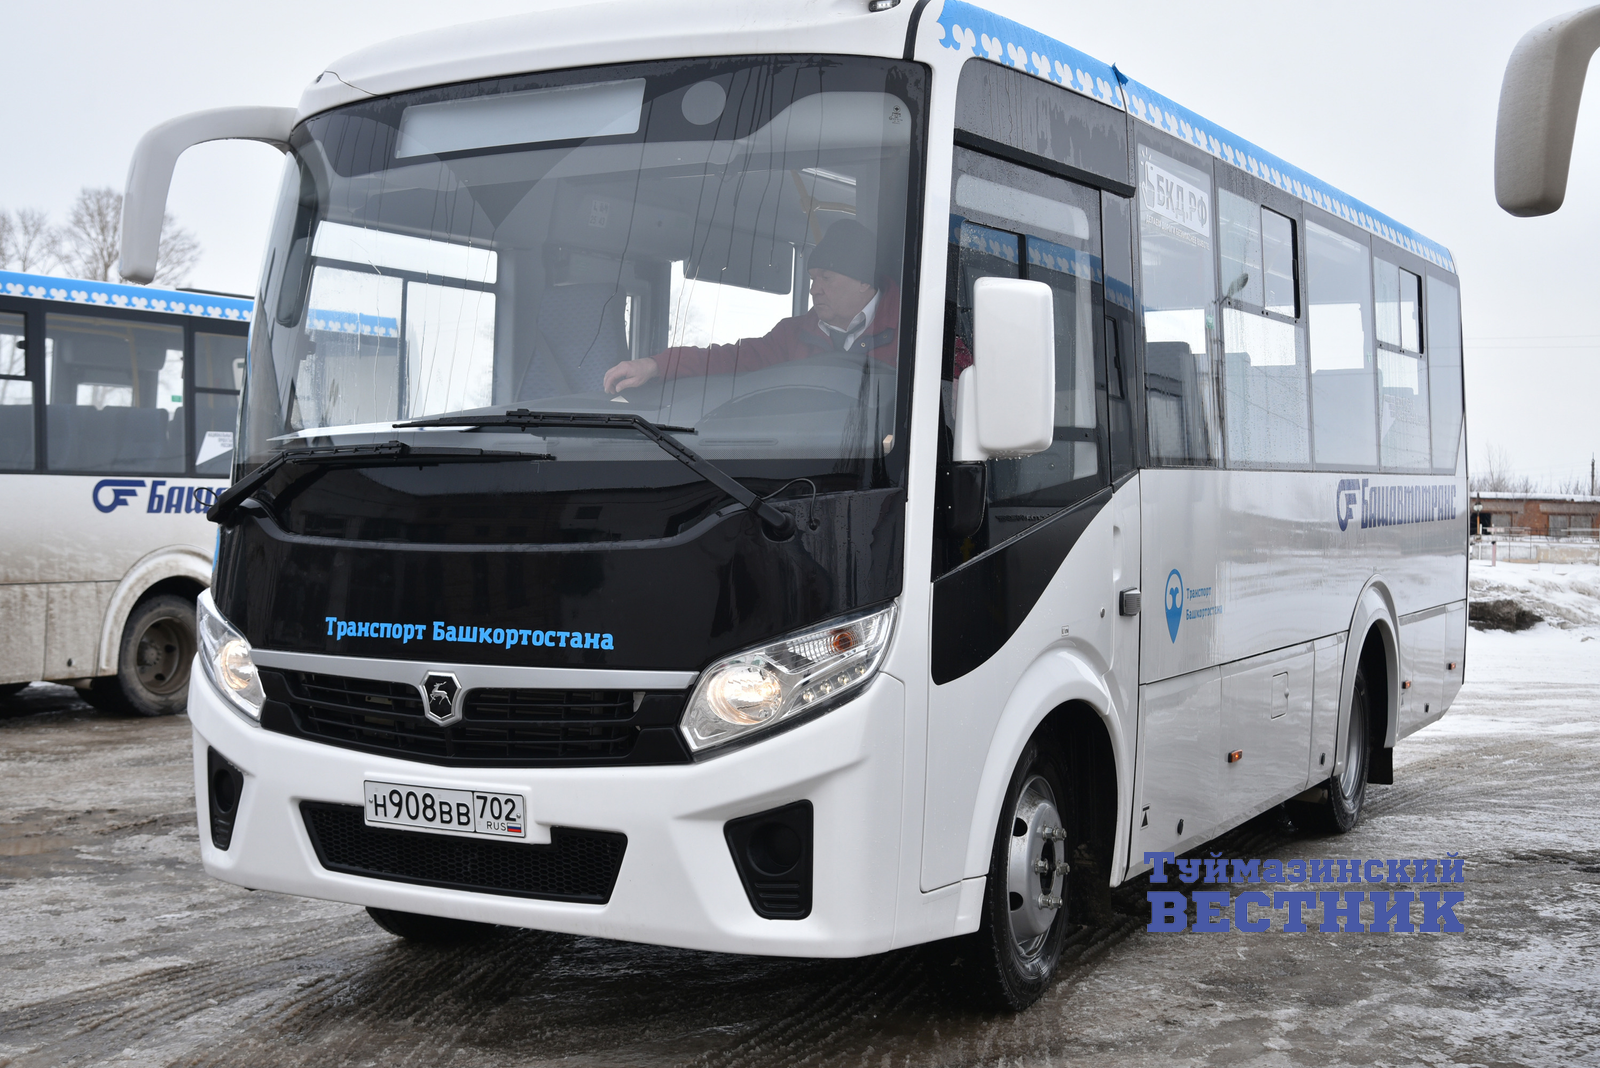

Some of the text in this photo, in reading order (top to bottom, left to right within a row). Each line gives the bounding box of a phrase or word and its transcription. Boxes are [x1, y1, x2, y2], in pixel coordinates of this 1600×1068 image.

[1156, 173, 1208, 229] БКД.РФ
[147, 480, 228, 513] Баш
[1186, 586, 1212, 601] Транспорт
[1186, 604, 1223, 621] Башкортостана
[325, 616, 614, 650] Транспорт Башкортостана
[475, 795, 516, 821] 702
[486, 820, 507, 832] RUS
